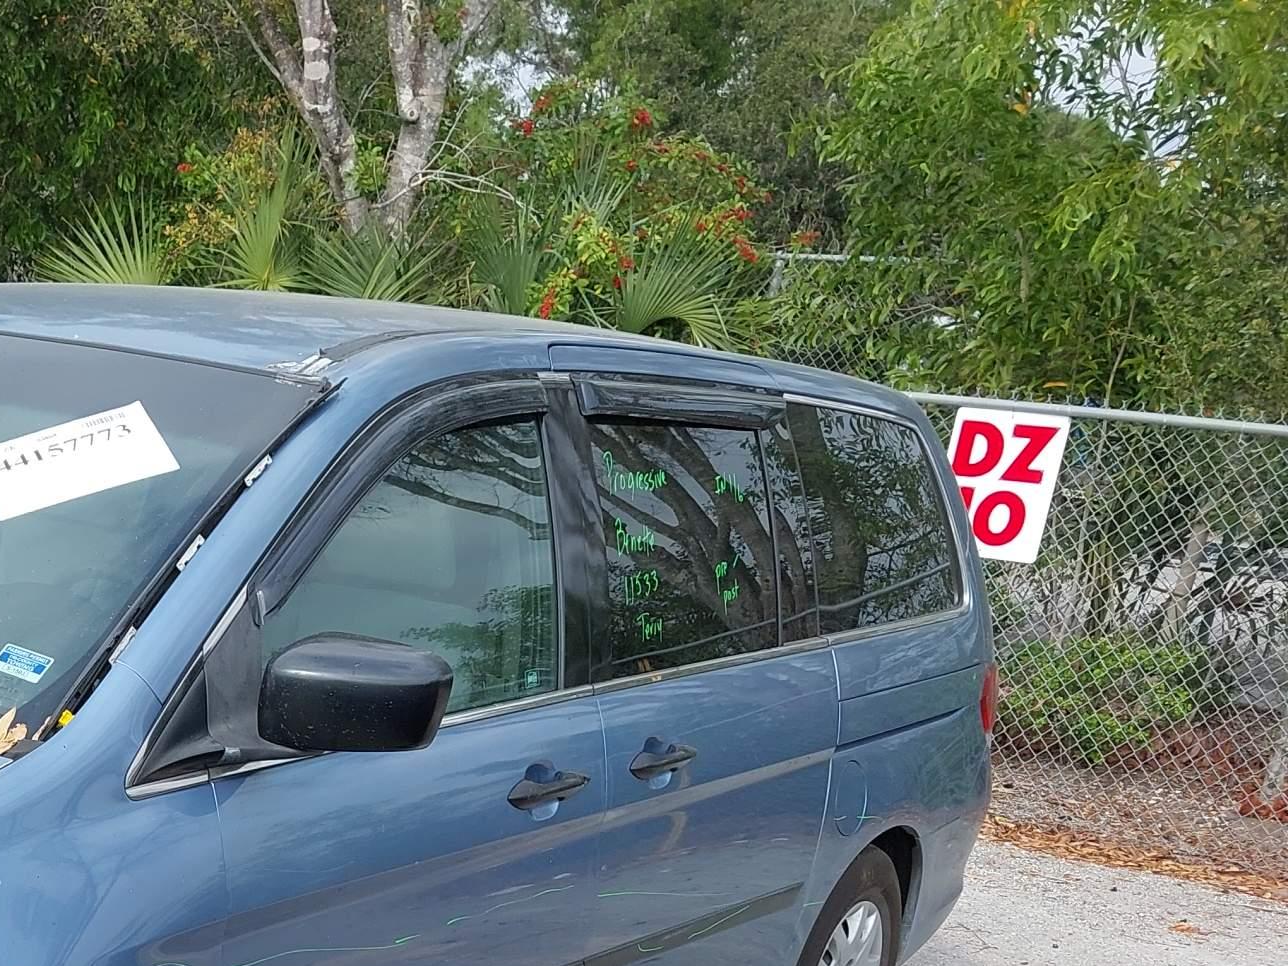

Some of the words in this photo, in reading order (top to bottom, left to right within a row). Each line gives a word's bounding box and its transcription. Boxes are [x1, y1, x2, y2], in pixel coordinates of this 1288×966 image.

[603, 451, 667, 500] Progressive
[952, 420, 1061, 484] DZ
[960, 487, 1026, 546] 0
[625, 570, 658, 605] 11533
[723, 579, 739, 615] post
